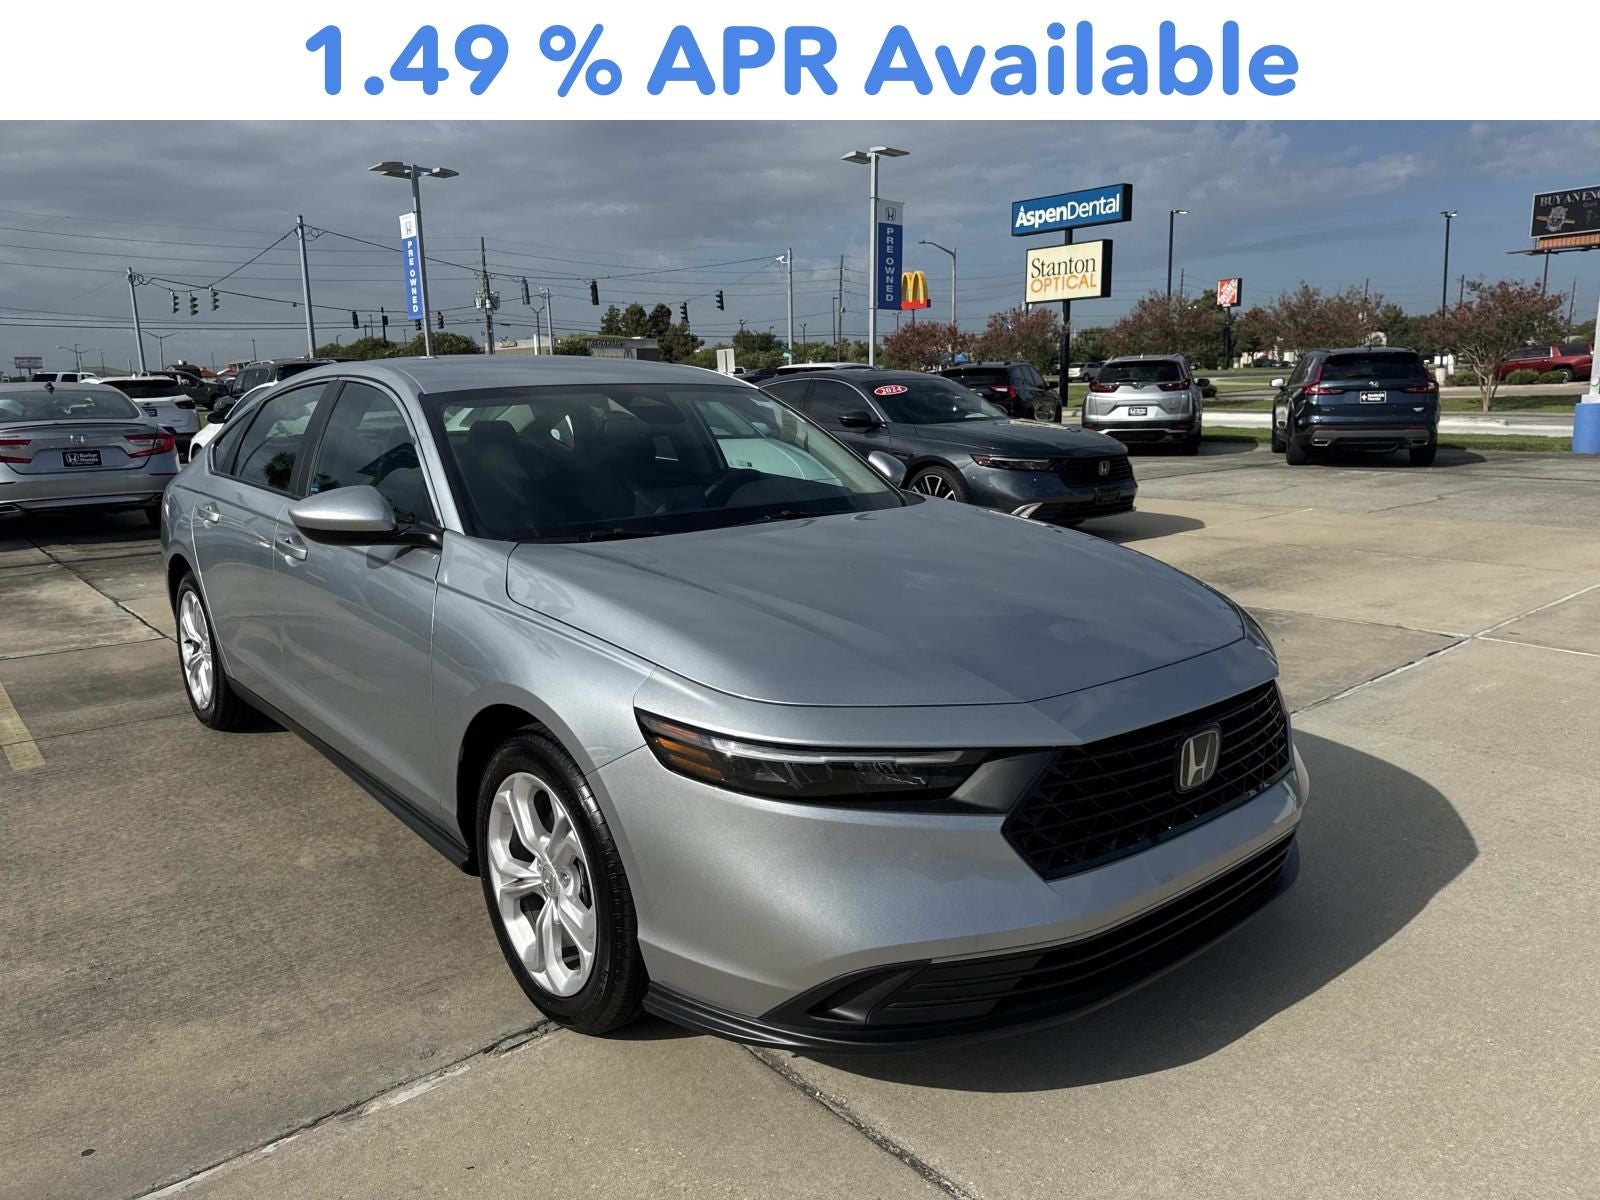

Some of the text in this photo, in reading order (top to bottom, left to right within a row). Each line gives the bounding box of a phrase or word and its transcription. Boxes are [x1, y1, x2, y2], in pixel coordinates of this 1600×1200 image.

[1540, 195, 1563, 207] BUY
[1582, 189, 1600, 201] EN
[885, 227, 895, 302] PRE OWNED
[1031, 257, 1096, 279] Stanton
[410, 269, 419, 313] OWNED
[1030, 273, 1097, 293] OPTICAL
